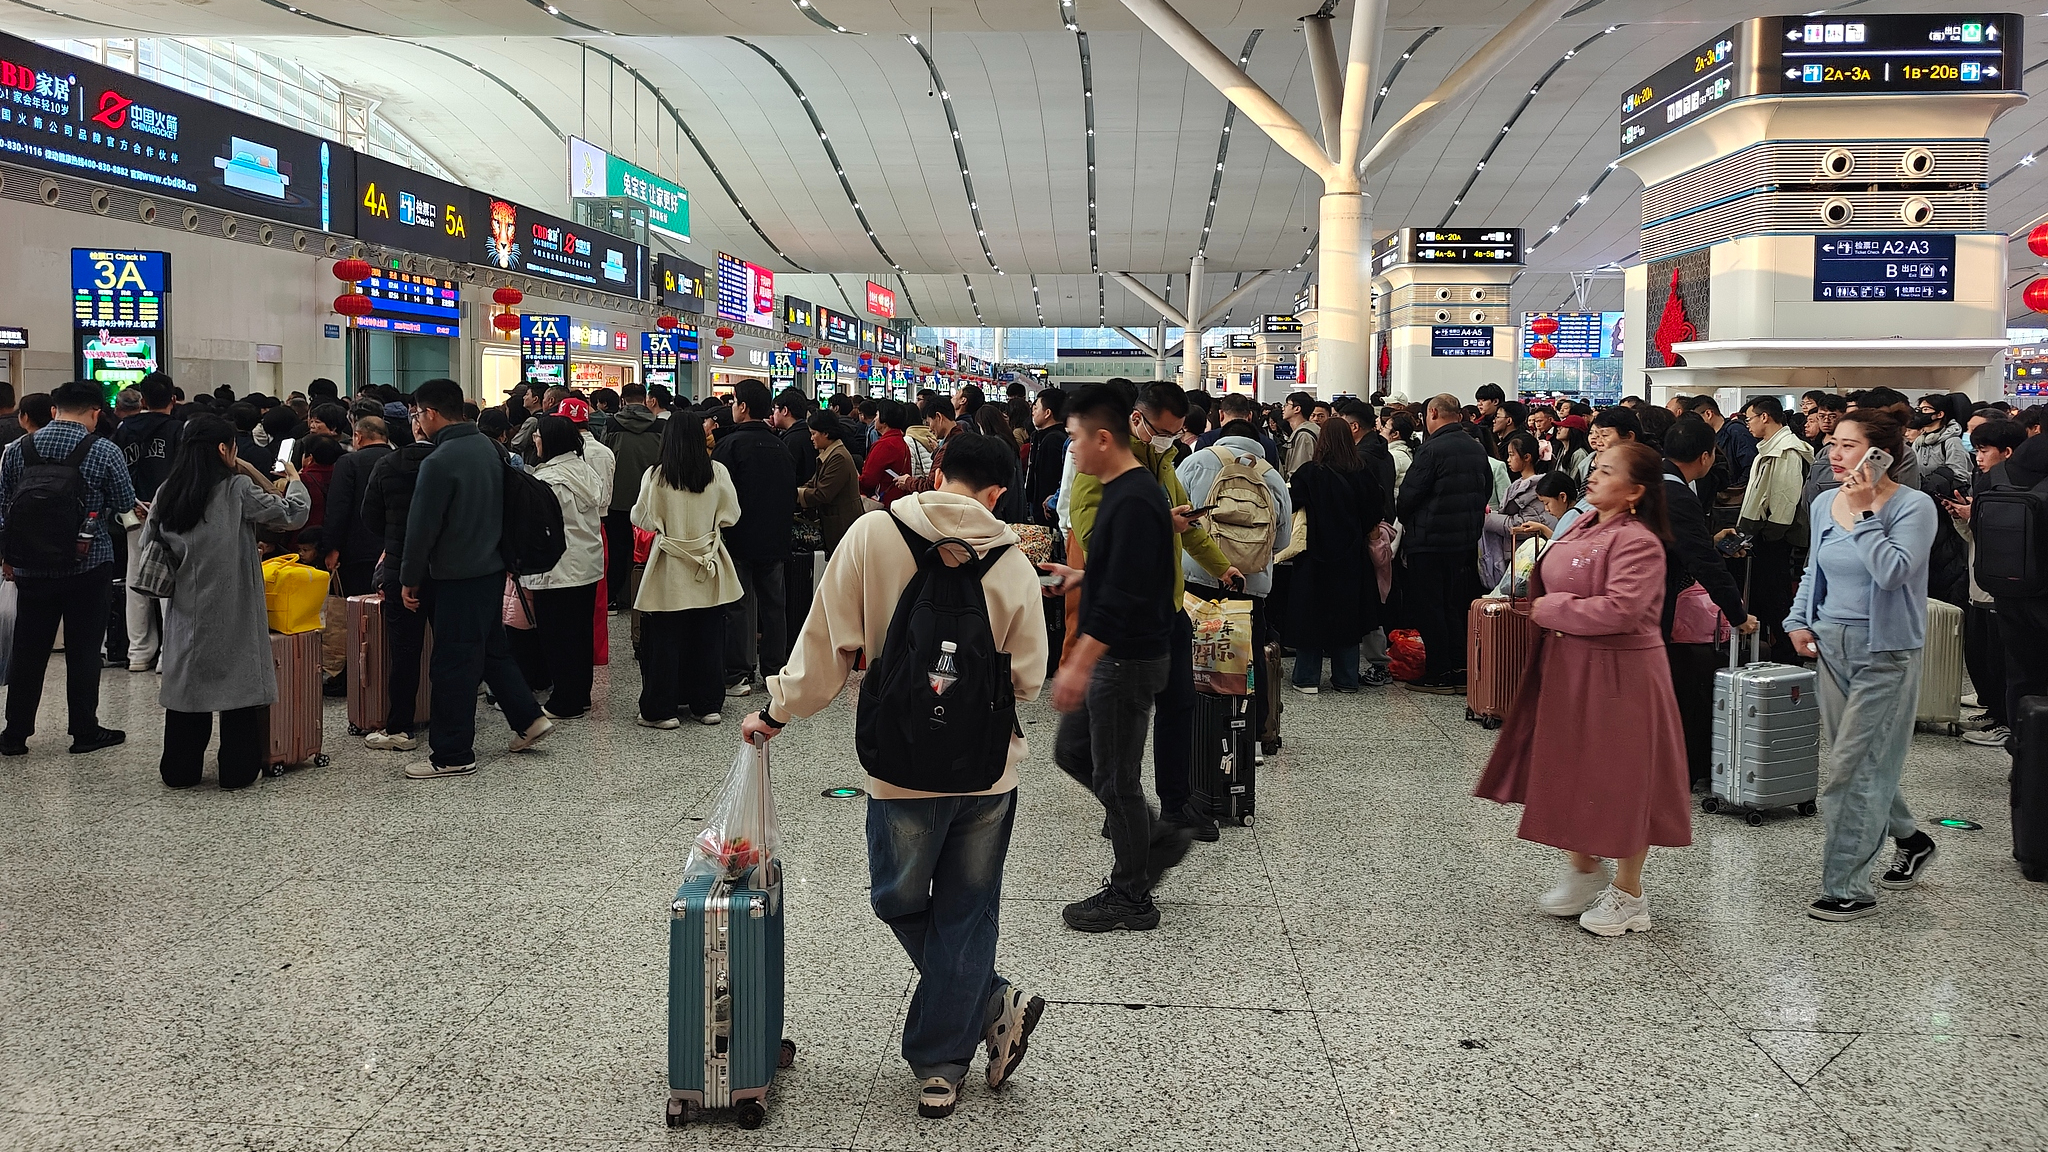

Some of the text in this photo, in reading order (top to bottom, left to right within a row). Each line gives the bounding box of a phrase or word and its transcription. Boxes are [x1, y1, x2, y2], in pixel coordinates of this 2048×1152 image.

[1692, 49, 1716, 73] 2A-3A
[1824, 65, 1959, 81] 2A-3A 1B-20B
[130, 104, 178, 133] 中国火箭
[363, 182, 390, 219] 4A
[445, 204, 466, 239] 5A
[1435, 233, 1462, 241] 6A-20A
[1854, 241, 1879, 250] 检票口
[1434, 249, 1495, 258] 4A-5A 4B-5B
[94, 260, 147, 290] 3A
[1886, 264, 1898, 278] B
[1901, 264, 1918, 273] 出口
[531, 321, 559, 338] 4A
[650, 338, 672, 352] 5A
[775, 355, 792, 366] 6A
